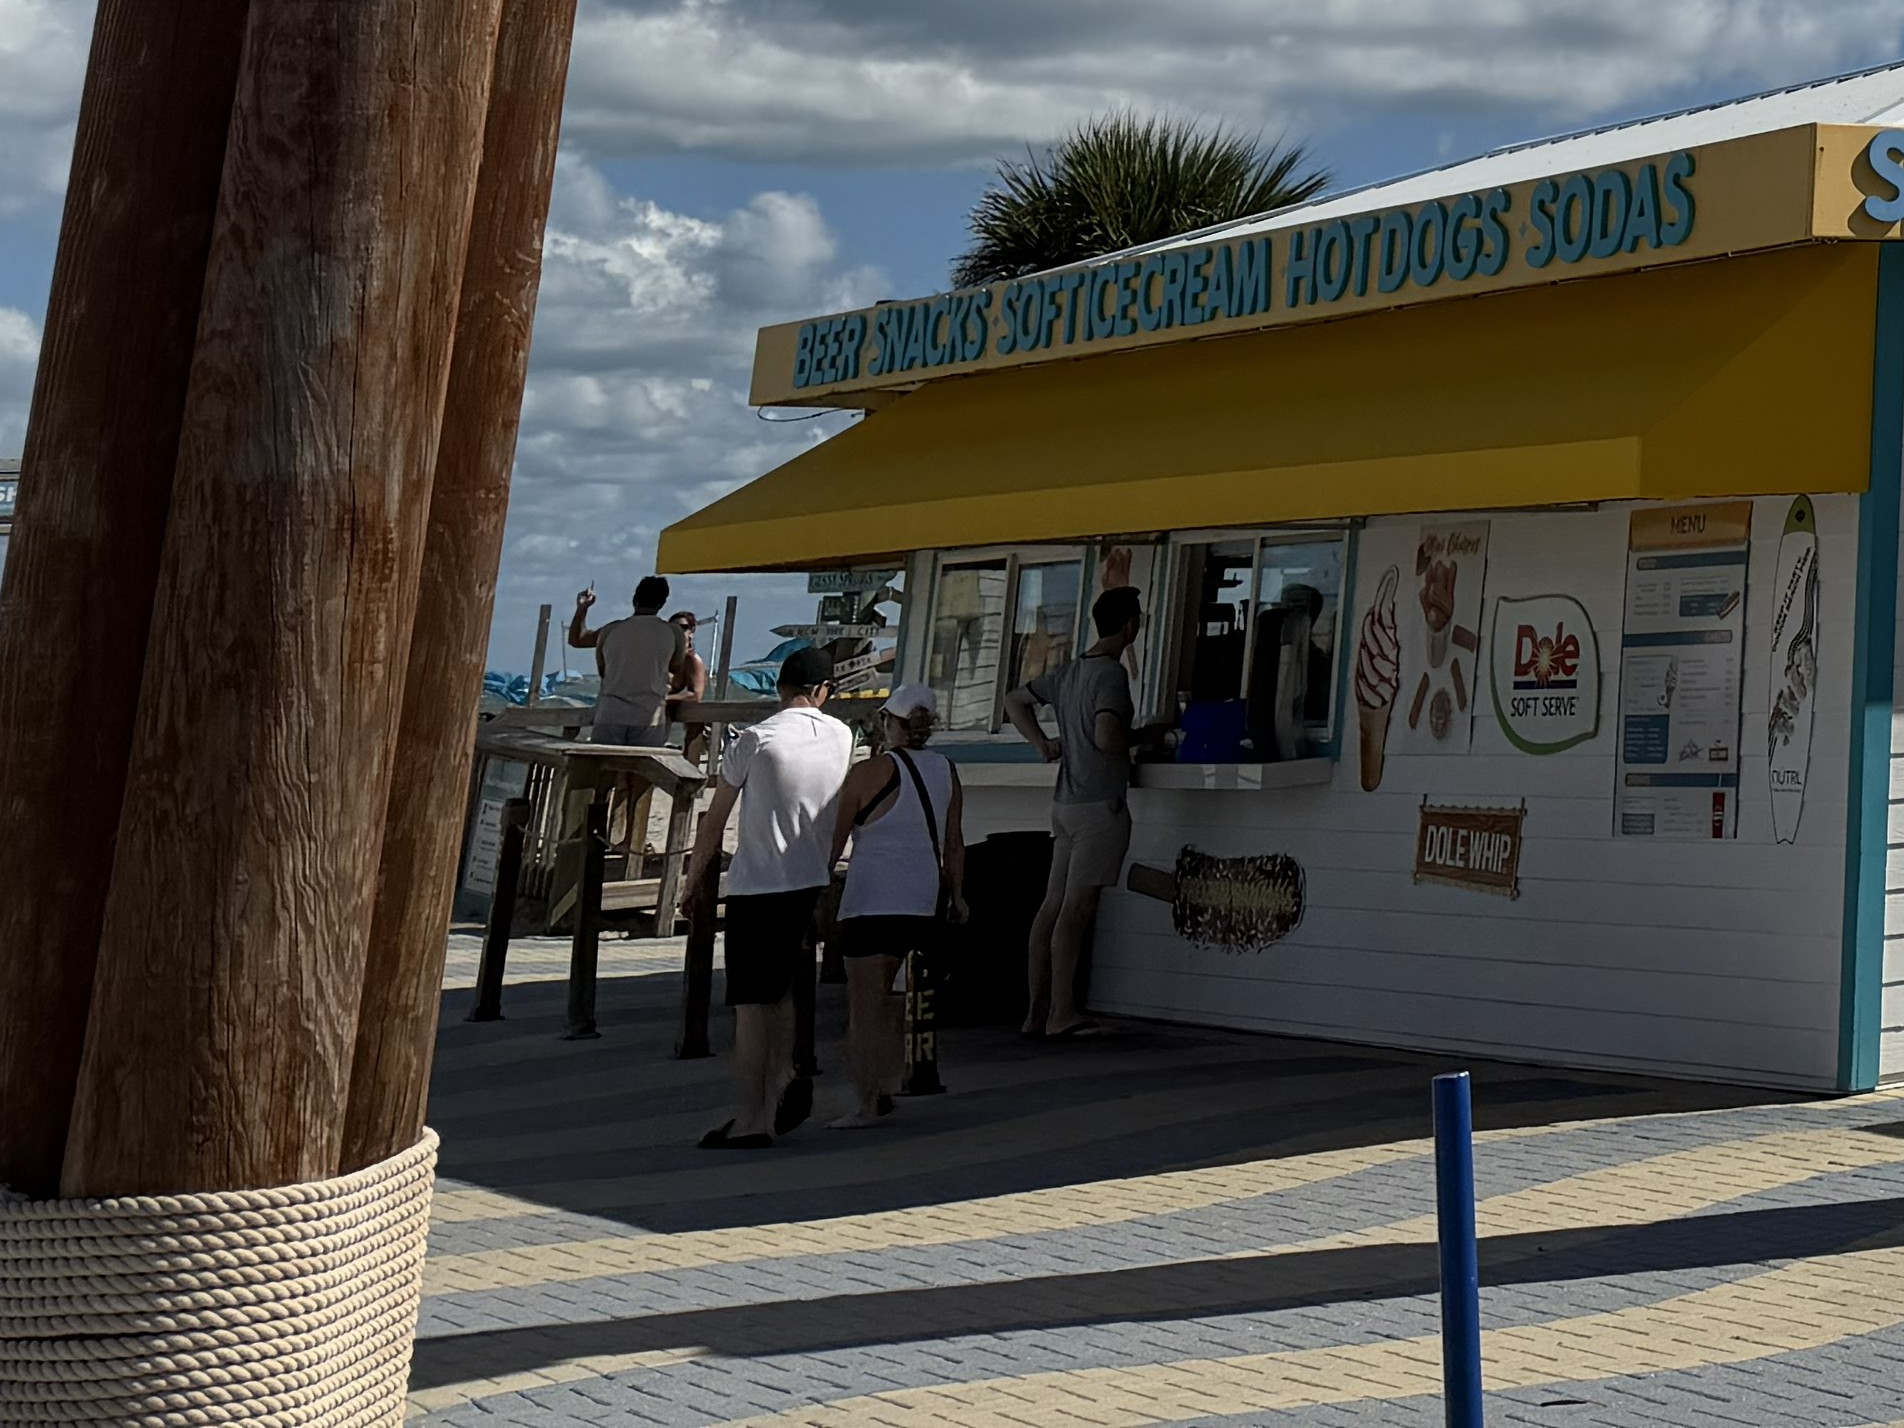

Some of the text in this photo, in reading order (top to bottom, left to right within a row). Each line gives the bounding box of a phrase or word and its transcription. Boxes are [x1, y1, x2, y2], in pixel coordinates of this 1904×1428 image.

[793, 314, 866, 388] BEER
[867, 288, 993, 376] SNACKS
[1524, 150, 1697, 269] SODAS
[1671, 513, 1706, 534] MENU
[1513, 621, 1580, 677] Dole
[1511, 695, 1577, 717] SOFT SERVE
[1424, 824, 1512, 874] DOLE WHIP
